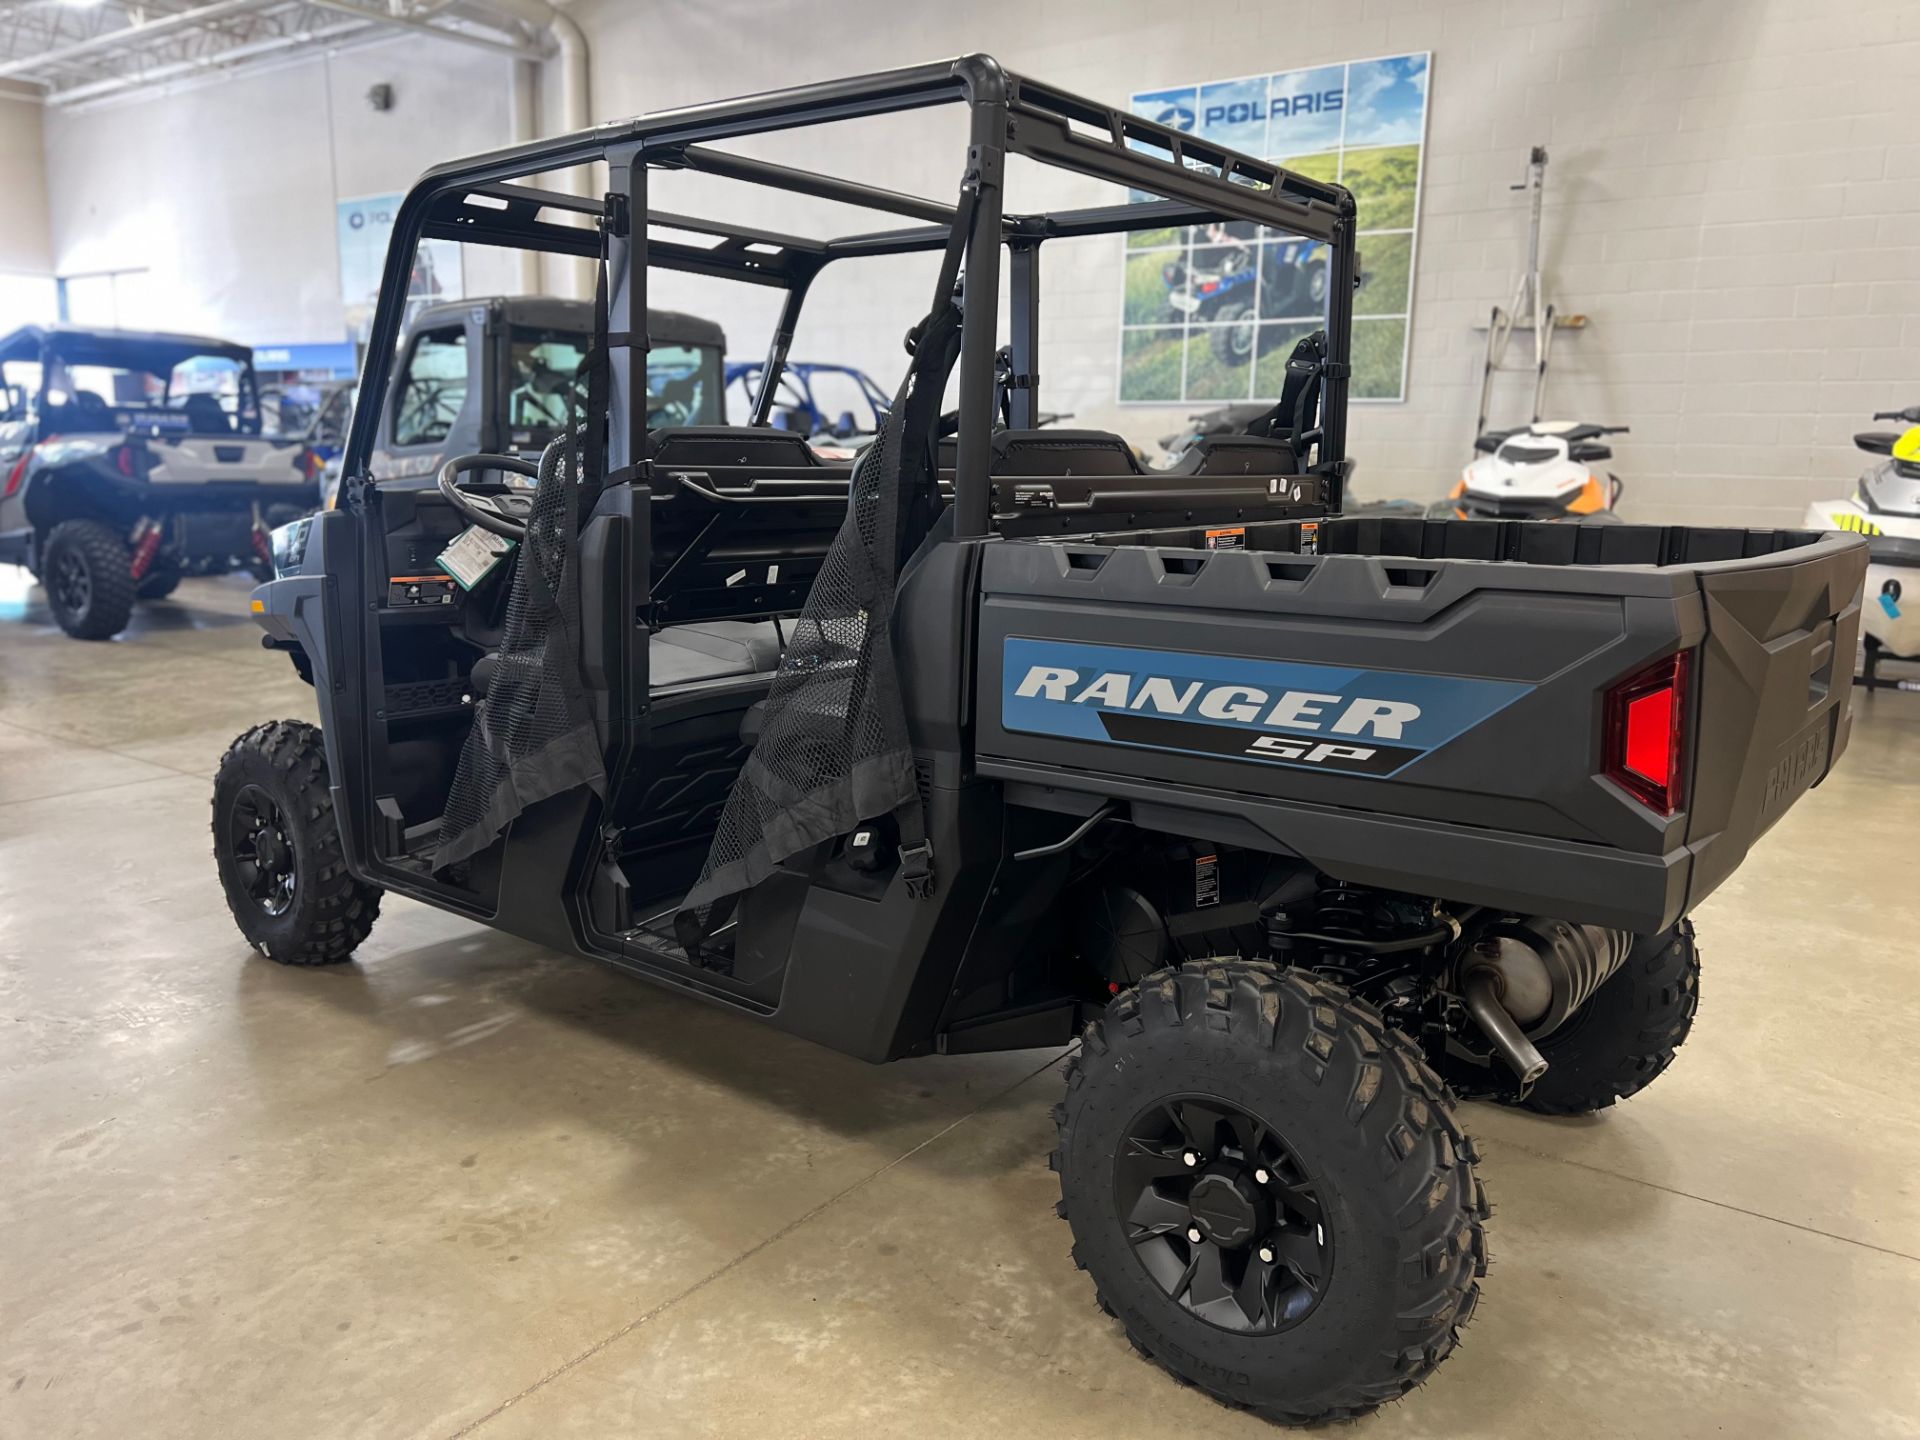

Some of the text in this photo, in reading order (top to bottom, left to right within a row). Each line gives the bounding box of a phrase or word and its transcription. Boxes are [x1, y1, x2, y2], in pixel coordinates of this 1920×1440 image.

[1205, 88, 1345, 127] POLARIS
[1014, 665, 1421, 740] RANGER
[1244, 736, 1377, 762] SP
